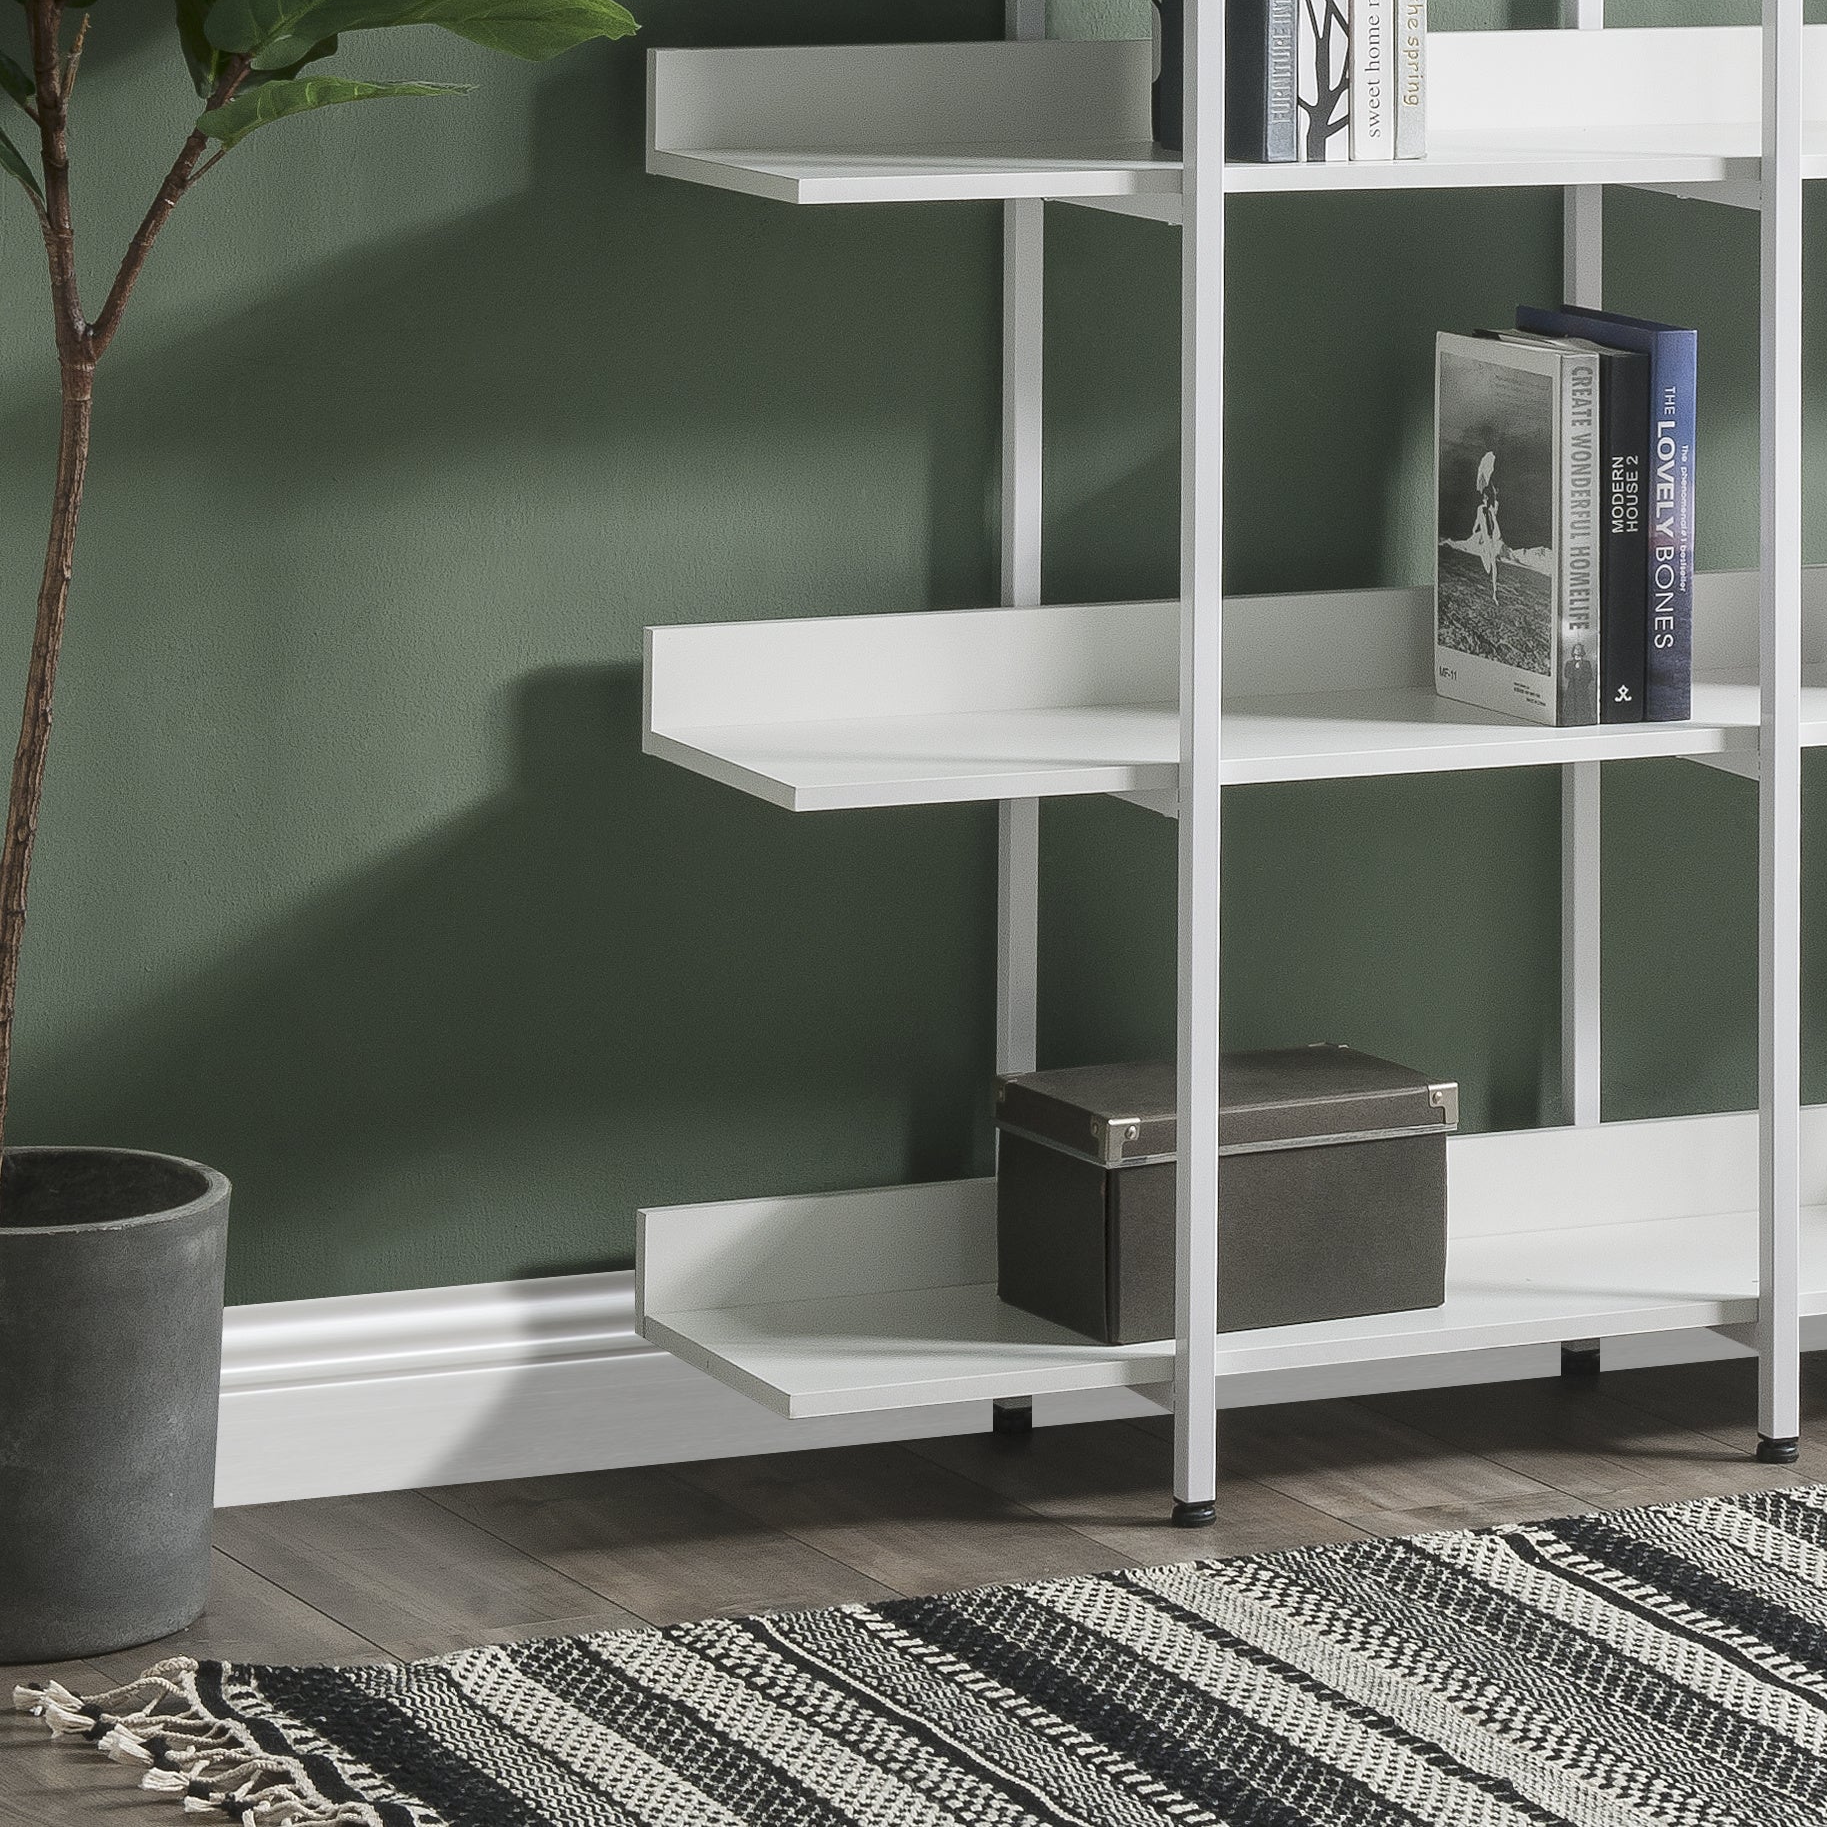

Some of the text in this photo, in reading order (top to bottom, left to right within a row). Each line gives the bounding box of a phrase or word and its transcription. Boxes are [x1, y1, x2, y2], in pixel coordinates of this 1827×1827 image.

[1364, 15, 1380, 73] home
[1403, 36, 1425, 107] spring
[1368, 79, 1381, 138] sweet
[1568, 365, 1594, 632] CREATE WONDERFUL HOMELIFE
[1611, 456, 1624, 534] MODERN
[1626, 455, 1639, 533] HOUSE 2
[1654, 386, 1676, 649] THE LOVELY BONES
